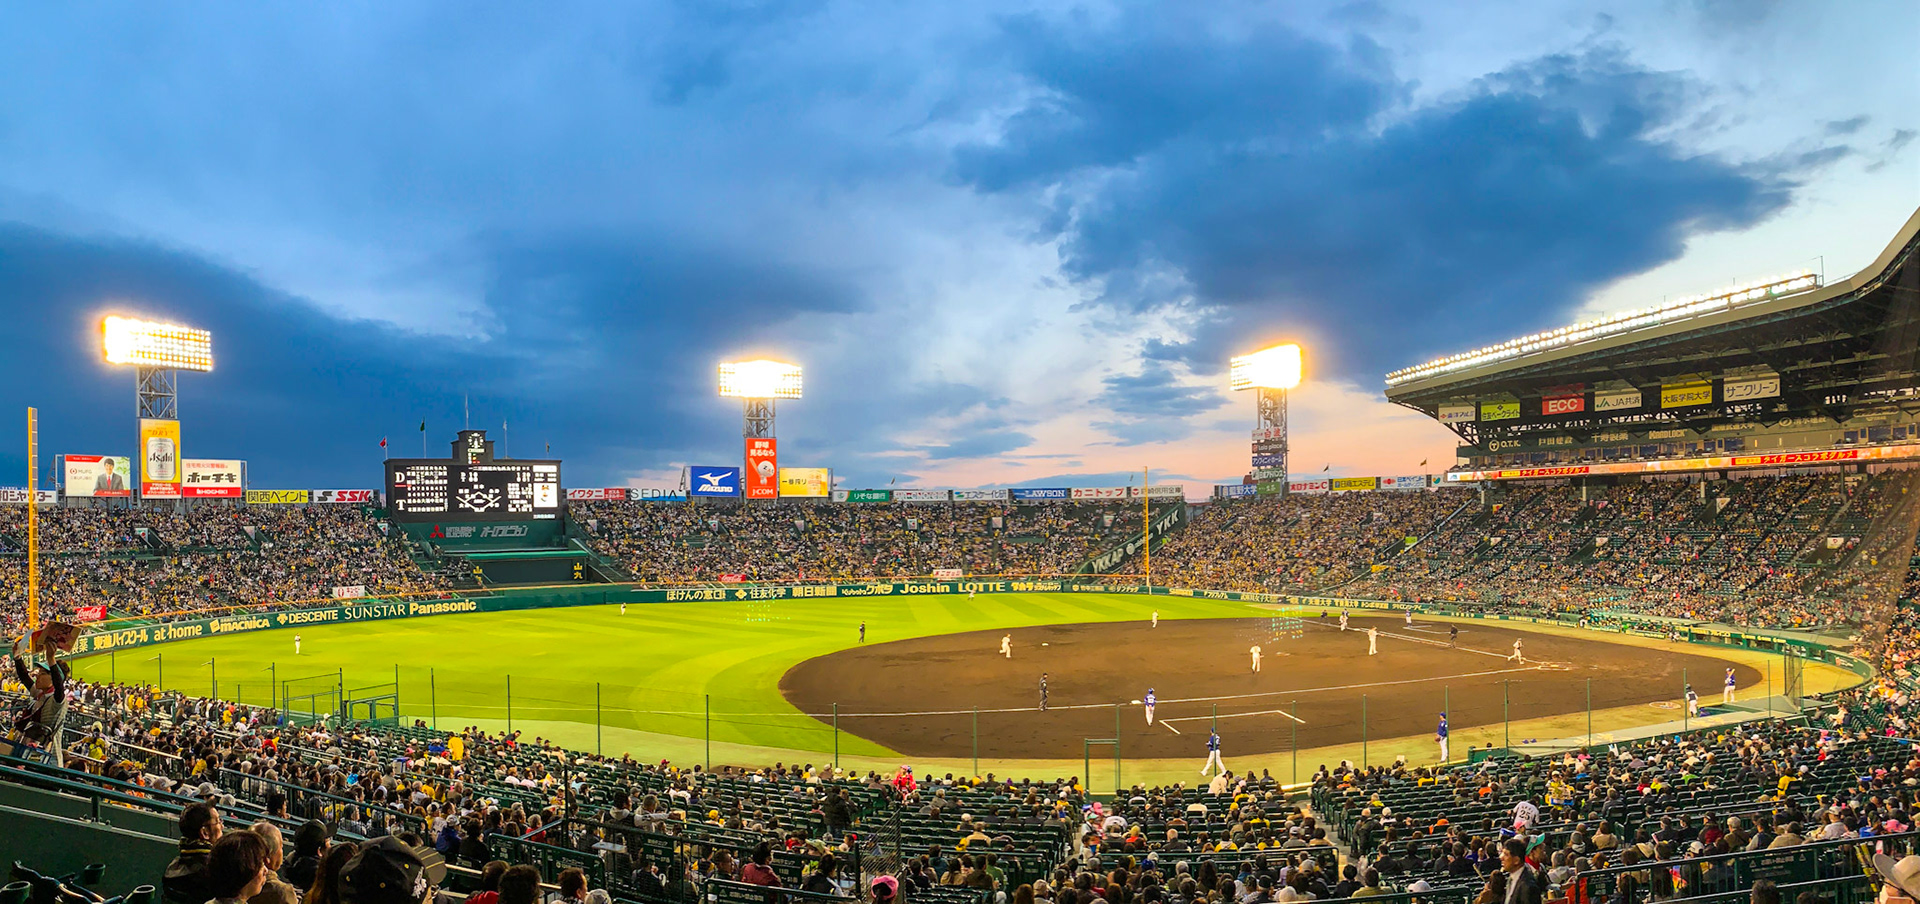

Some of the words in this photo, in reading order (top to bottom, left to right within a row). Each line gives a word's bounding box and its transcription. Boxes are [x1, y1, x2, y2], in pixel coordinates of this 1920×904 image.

[1725, 381, 1778, 398] サニクリーン
[1611, 392, 1641, 407] JA共済
[1662, 389, 1711, 404] 大阪学院大学
[1548, 398, 1578, 412] ECC
[755, 441, 769, 449] 野球
[149, 452, 173, 463] Asahi
[750, 449, 775, 457] 見るなら
[186, 472, 237, 483] ホーチキ
[395, 472, 406, 483] D
[247, 490, 308, 503] 関西ペイント
[335, 490, 371, 502] SSK
[568, 489, 603, 499] イワタニ
[853, 492, 886, 500] りそな銀行
[964, 490, 1006, 499] エスケー化研
[1025, 489, 1065, 498] LAWSON
[1073, 487, 1125, 497] カニトップ
[395, 499, 406, 511] T
[1156, 509, 1179, 535] YKK
[750, 587, 786, 599] 住友化学
[792, 586, 837, 597] 朝日新聞
[866, 584, 893, 595] クボタ
[900, 583, 950, 594] Joshin
[958, 582, 1006, 593] LOTTE
[77, 607, 102, 619] Coca-Cola
[344, 604, 405, 620] SUNSTAR
[409, 599, 477, 615] Panasonic
[289, 610, 338, 624] DESCENTE
[154, 628, 167, 641] at
[168, 624, 202, 639] home
[93, 629, 149, 651] 東進ハイスクール
[1518, 809, 1531, 821] 25
